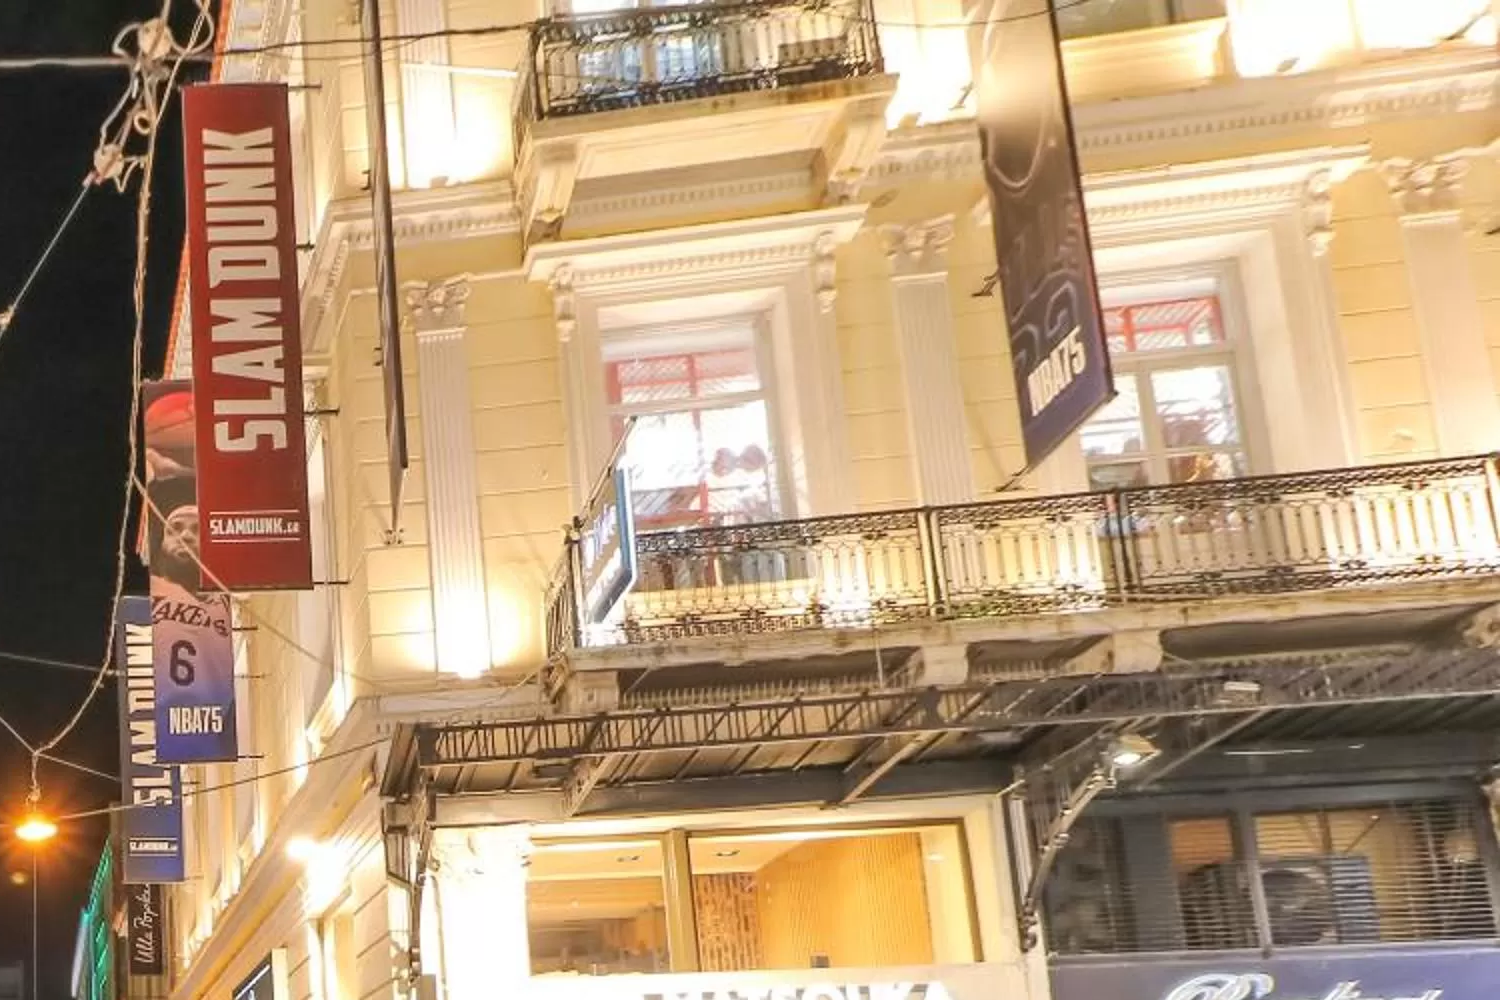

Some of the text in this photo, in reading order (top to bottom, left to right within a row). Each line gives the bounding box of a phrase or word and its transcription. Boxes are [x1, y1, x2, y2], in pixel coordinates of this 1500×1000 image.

[201, 126, 288, 453] SLAM DUNK
[1027, 324, 1087, 417] NBA75
[169, 639, 198, 687] 6
[168, 706, 223, 735] NBA75
